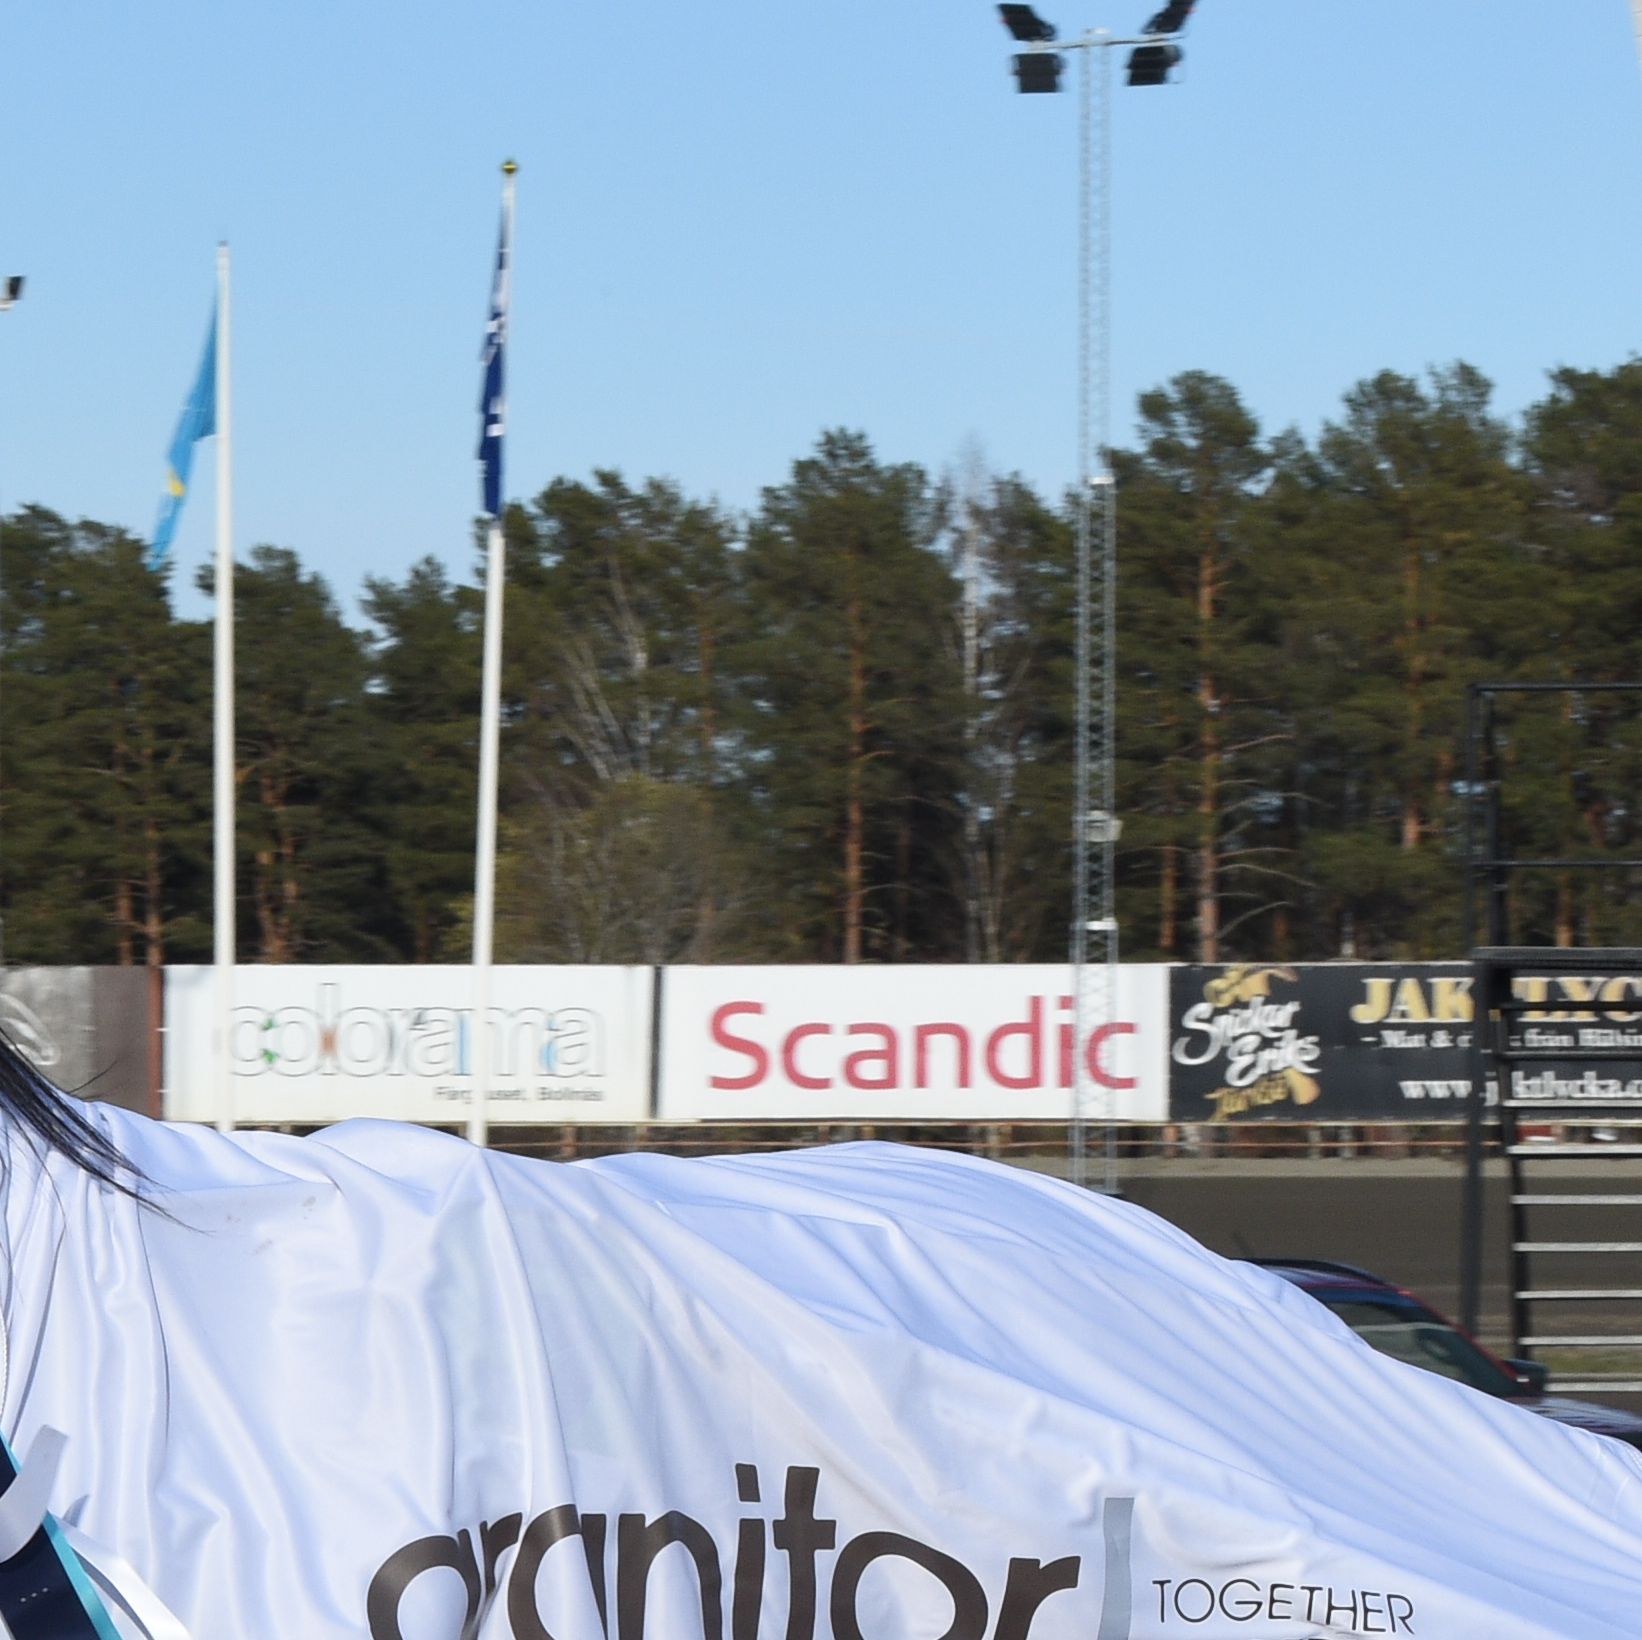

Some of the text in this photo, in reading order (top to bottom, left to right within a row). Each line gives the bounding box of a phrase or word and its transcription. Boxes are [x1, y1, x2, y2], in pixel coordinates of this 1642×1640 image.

[223, 982, 607, 1078] colorama
[708, 995, 1139, 1091] Scandic
[1151, 1577, 1416, 1636] TOGETHER
